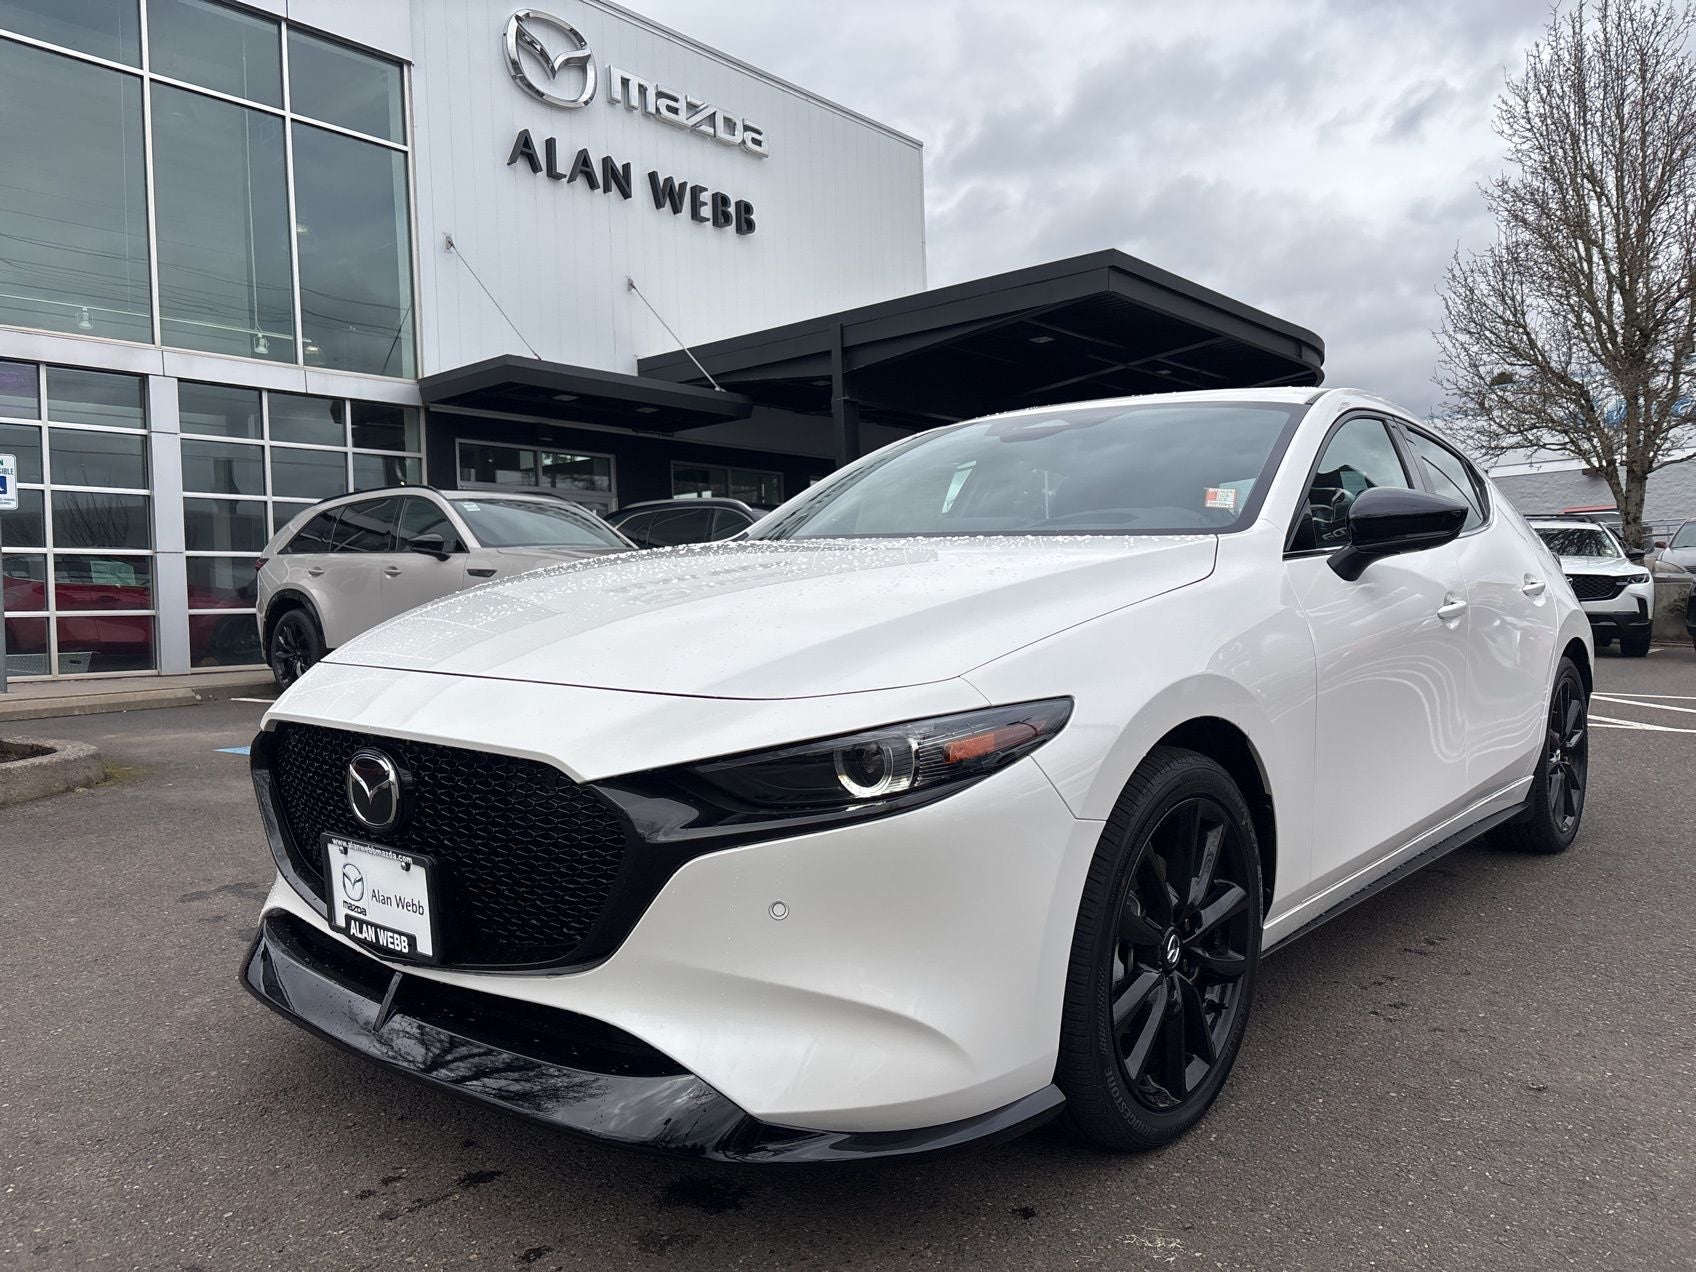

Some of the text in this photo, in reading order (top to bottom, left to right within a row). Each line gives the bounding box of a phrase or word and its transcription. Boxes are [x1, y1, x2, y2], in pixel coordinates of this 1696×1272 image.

[506, 128, 756, 236] ALAN WEBB
[331, 838, 413, 864] www.alanwebbmazda.com
[342, 900, 367, 917] mazda
[371, 888, 425, 916] Alan Webb
[350, 919, 409, 953] ALAN WEBB
